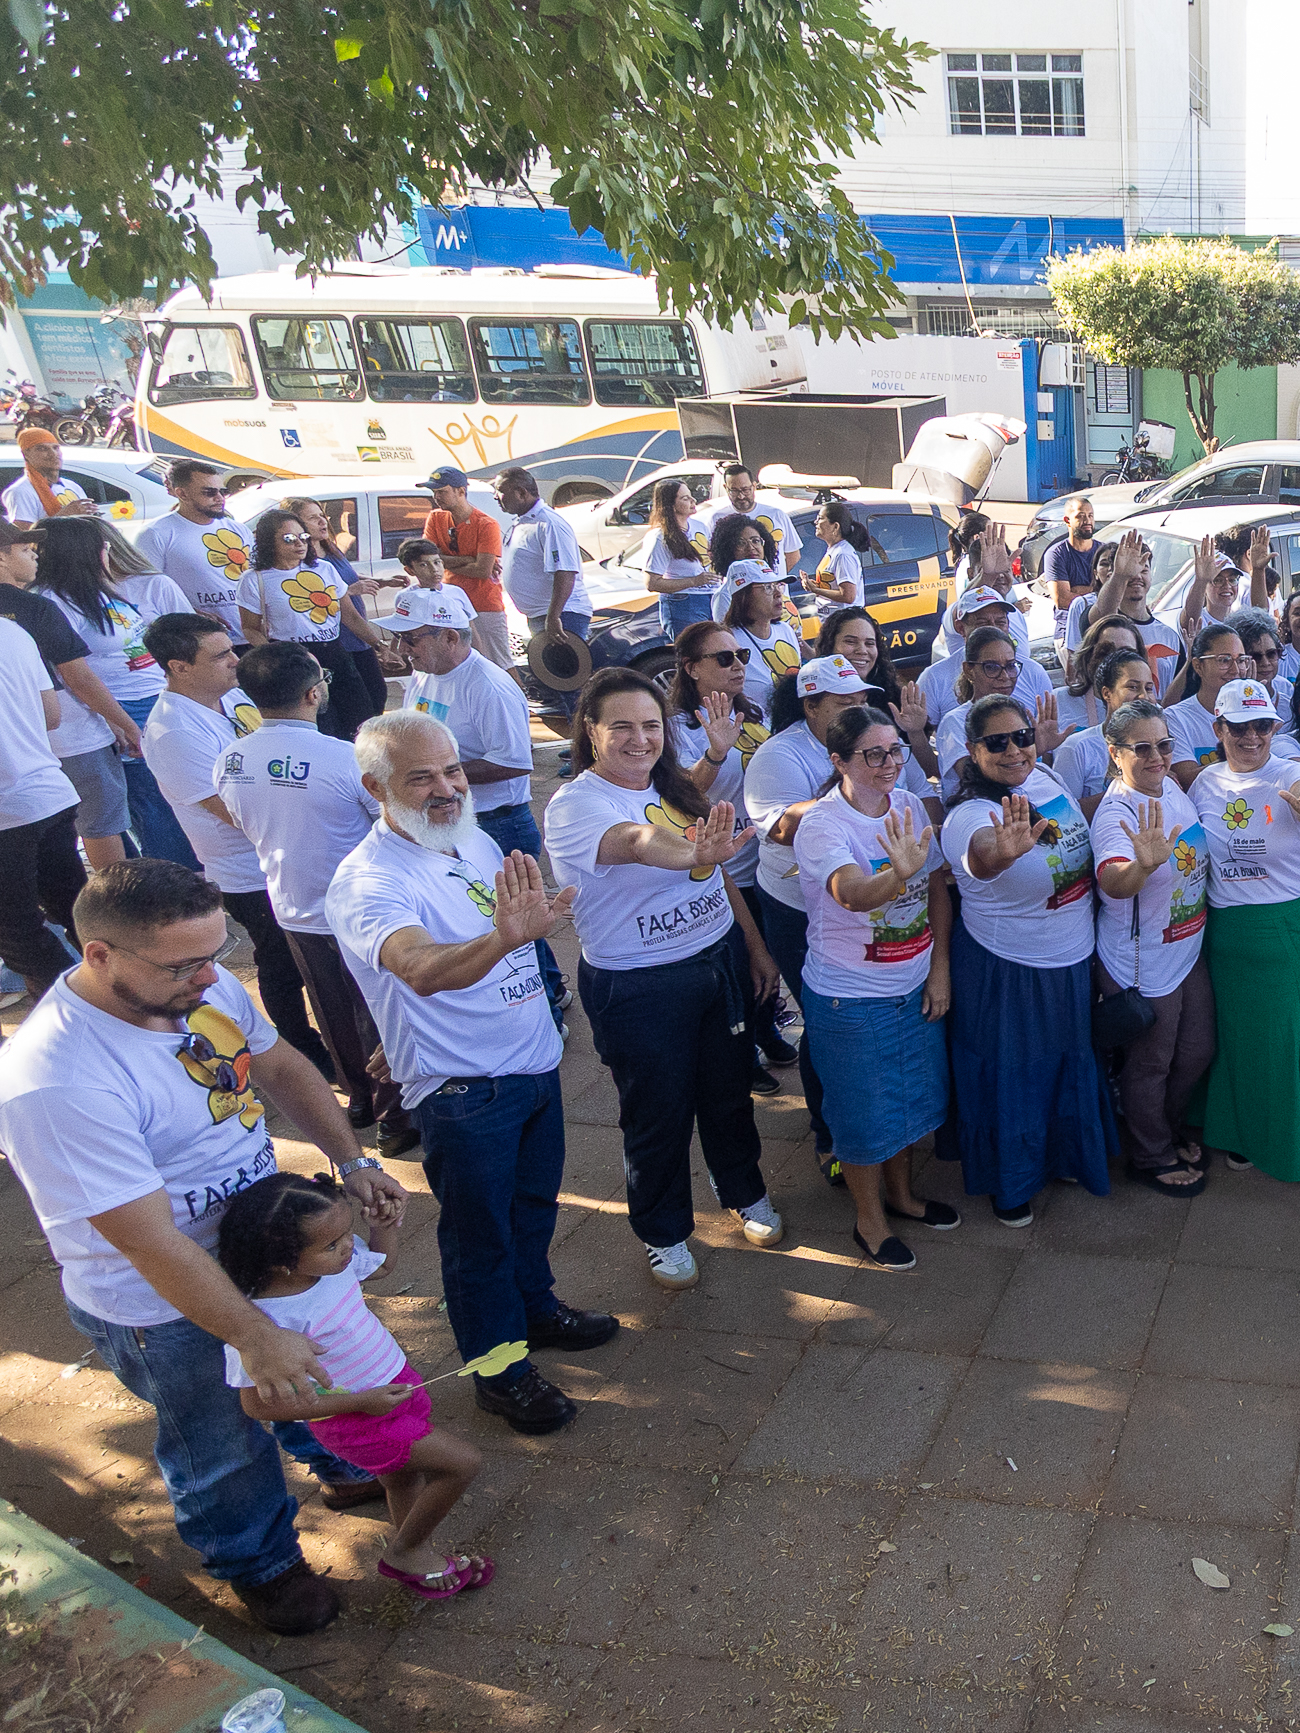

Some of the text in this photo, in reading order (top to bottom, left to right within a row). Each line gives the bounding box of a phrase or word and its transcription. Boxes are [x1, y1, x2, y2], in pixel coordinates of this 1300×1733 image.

[871, 369, 988, 383] POSTO DE ATENDIMENTO
[871, 380, 906, 391] MÓVEL
[223, 418, 267, 428] mobsuas
[380, 451, 415, 461] BRASIL
[891, 580, 954, 593] PRESERVANDO
[636, 906, 688, 939] FAÇA
[184, 1166, 252, 1218] FAÇA
